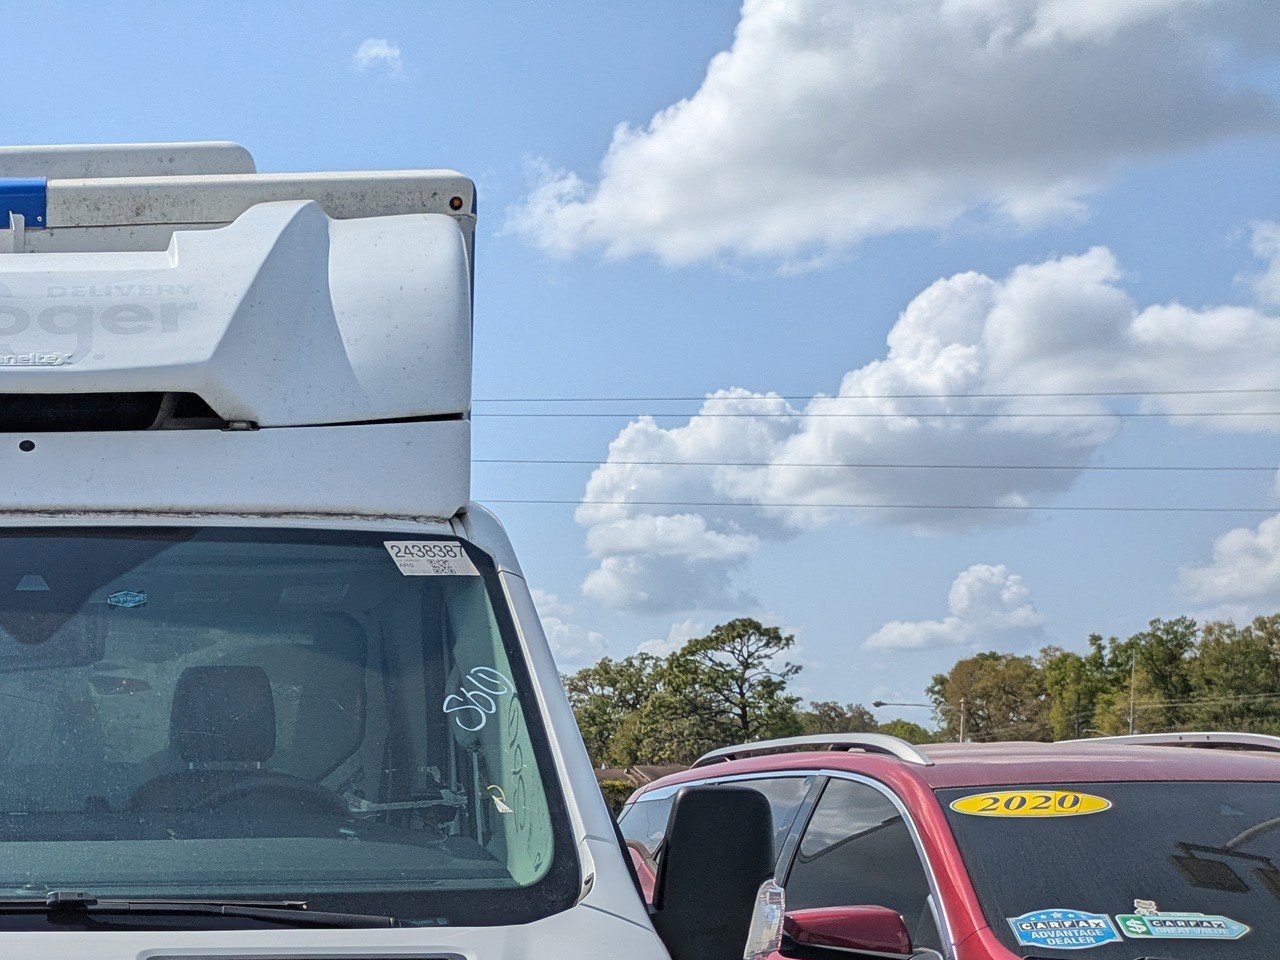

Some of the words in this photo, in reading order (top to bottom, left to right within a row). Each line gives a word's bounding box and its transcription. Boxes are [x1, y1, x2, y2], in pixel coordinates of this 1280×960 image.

[46, 284, 195, 298] DELIVERY
[390, 544, 464, 558] 2438387
[977, 793, 1081, 812] 2020
[1020, 919, 1107, 931] CARFAX
[1151, 919, 1227, 929] CARFAX
[1031, 928, 1105, 940] ADVANTAGE
[1046, 936, 1097, 946] DEALER
